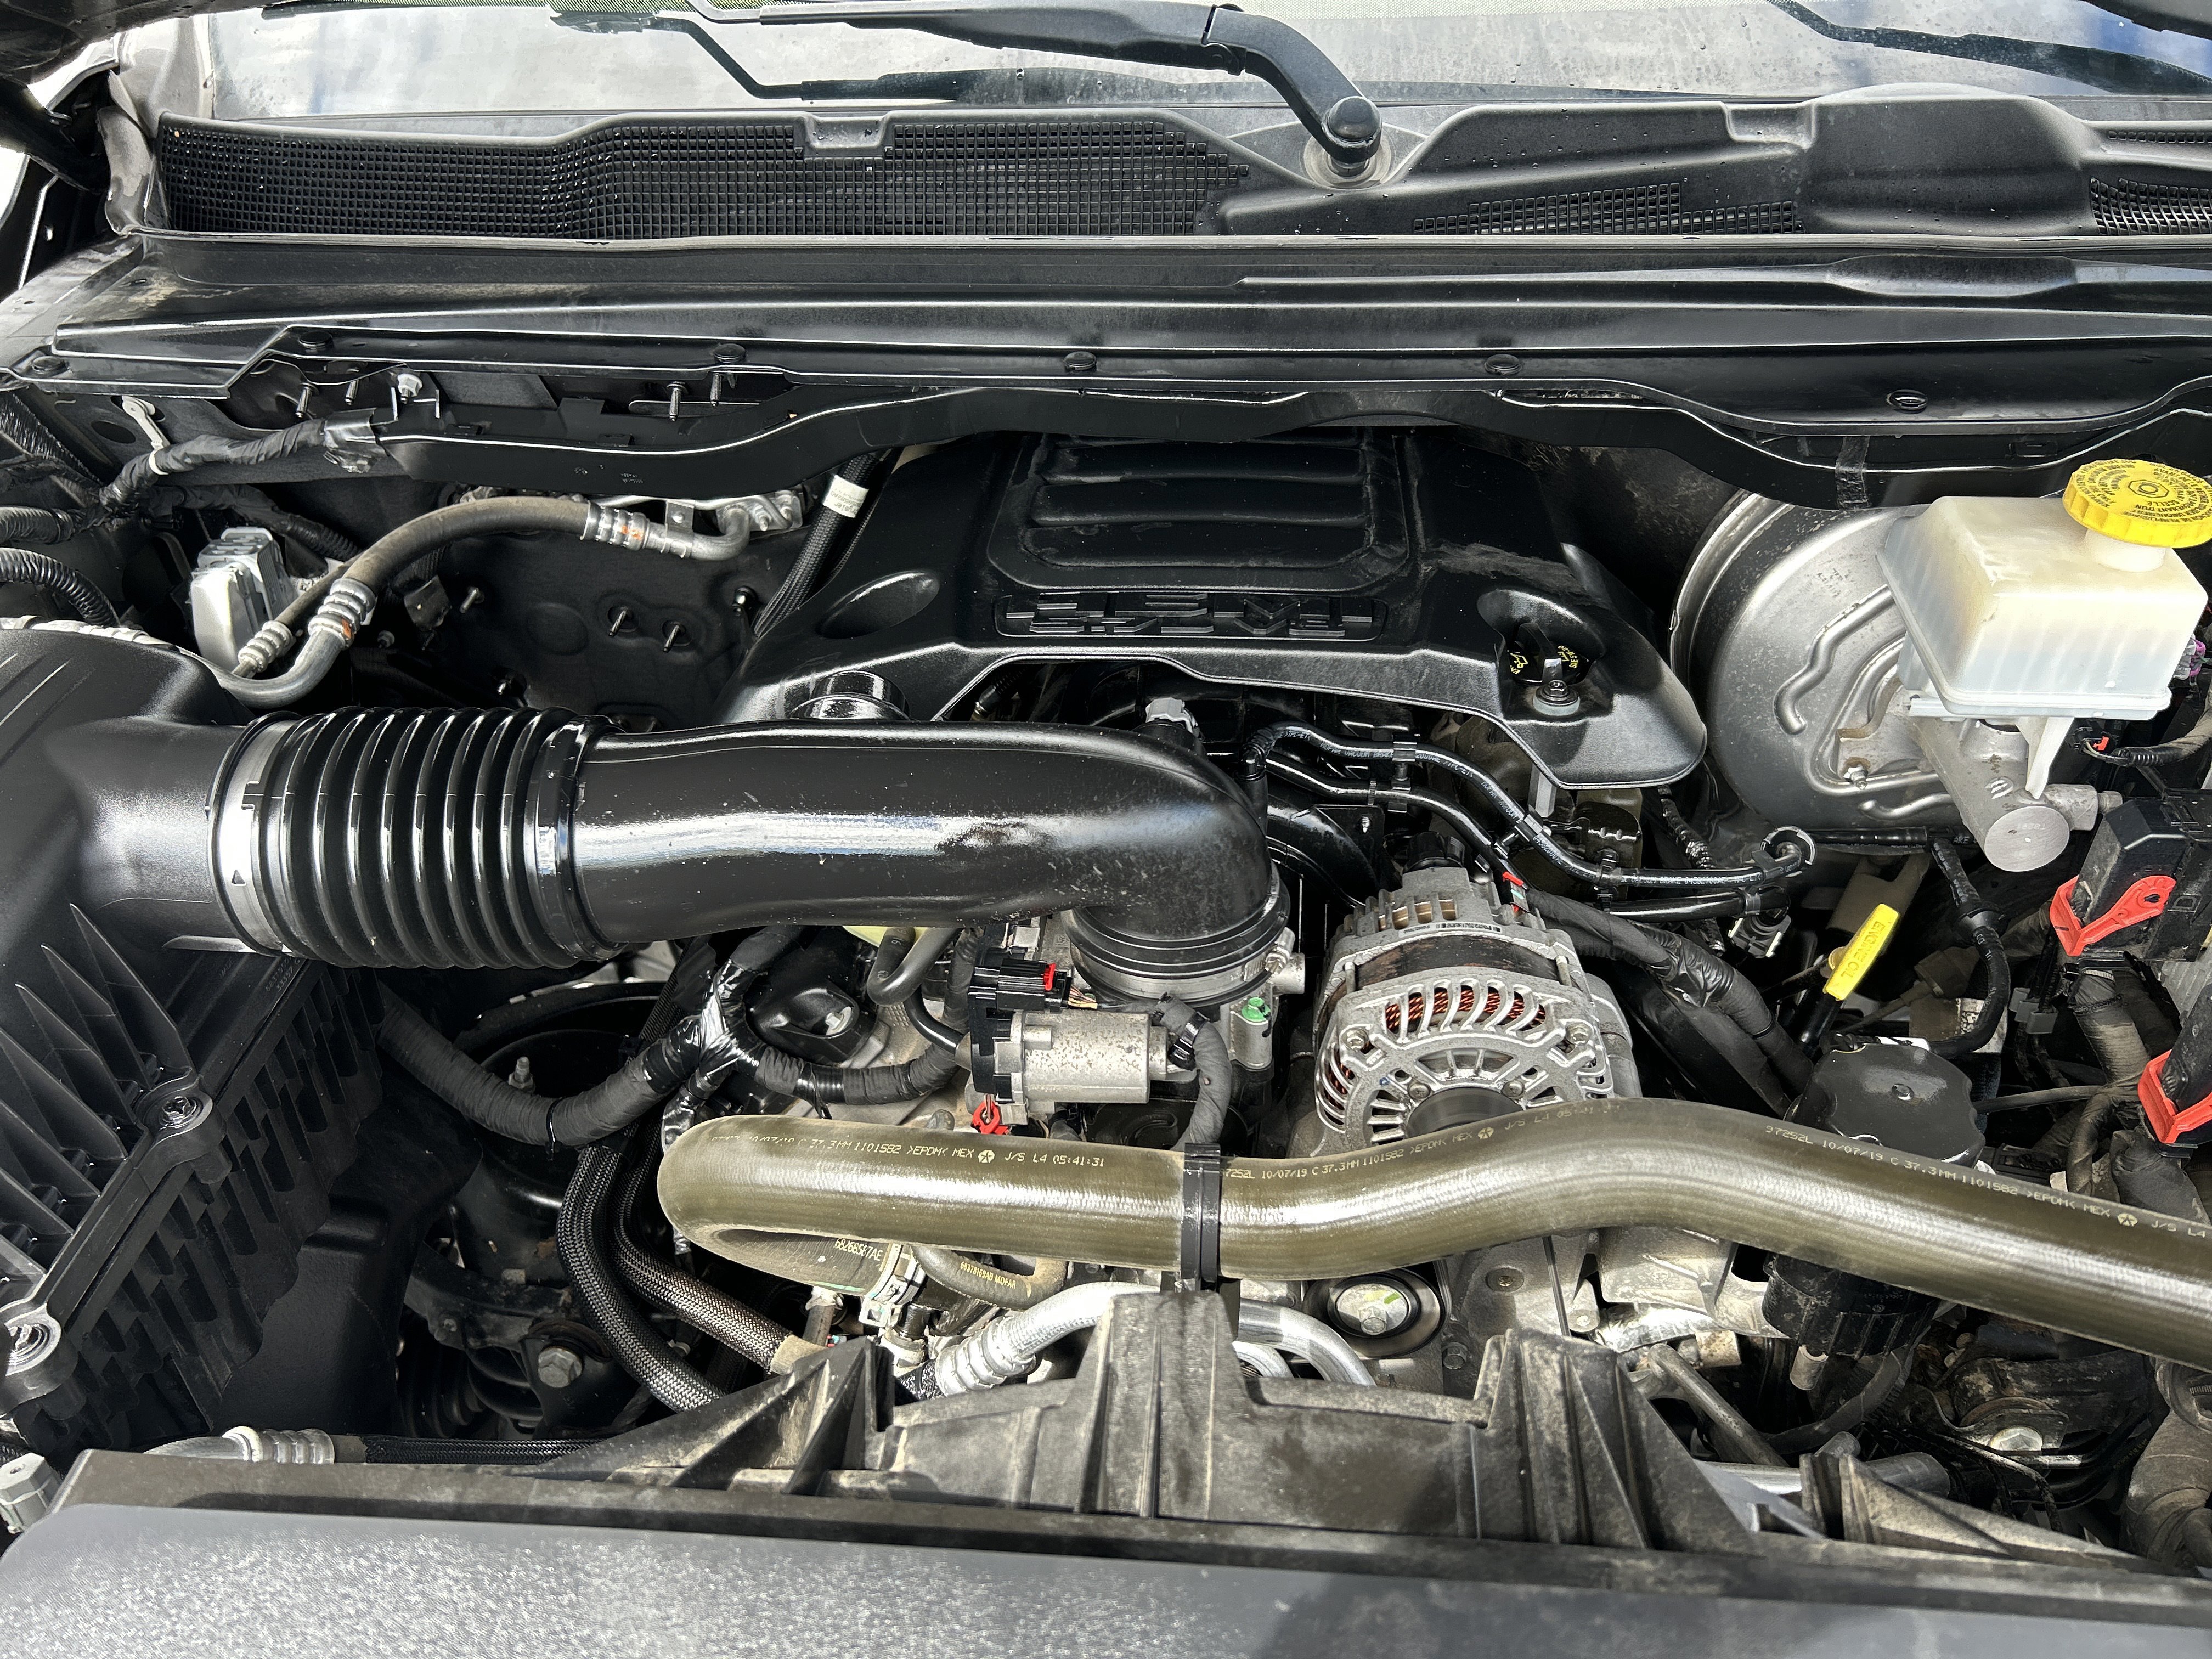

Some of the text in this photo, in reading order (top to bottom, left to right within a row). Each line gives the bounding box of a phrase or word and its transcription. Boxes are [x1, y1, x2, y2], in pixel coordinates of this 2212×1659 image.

[1006, 592, 1372, 623] HEMI
[1415, 753, 1441, 764] 2000AE
[1953, 835, 1970, 844] AKE
[1841, 921, 1886, 978] ENGINE OIL
[854, 1142, 902, 1154] 1101582
[952, 1148, 975, 1158] MEX
[1005, 1152, 1026, 1162] J/S
[1033, 1154, 1047, 1163] L4
[1052, 1155, 1105, 1167] 05:41:31
[1224, 1168, 1256, 1179] 7252L
[1262, 1168, 1308, 1179] 10/07/19
[1312, 1166, 1319, 1175] C
[1363, 1149, 1404, 1166] 1101582
[1452, 1131, 1473, 1143] MEX
[1765, 1125, 1813, 1145] 97252L
[1822, 1139, 1884, 1162] 10/07/19
[1891, 1157, 1899, 1166] C
[1961, 1174, 2019, 1196] 1101582
[2083, 1203, 2111, 1217] MEX
[2187, 1227, 2207, 1238] L4
[834, 1238, 884, 1262] 68268587AE
[960, 1261, 1017, 1289] 68378169AB MOPAR
